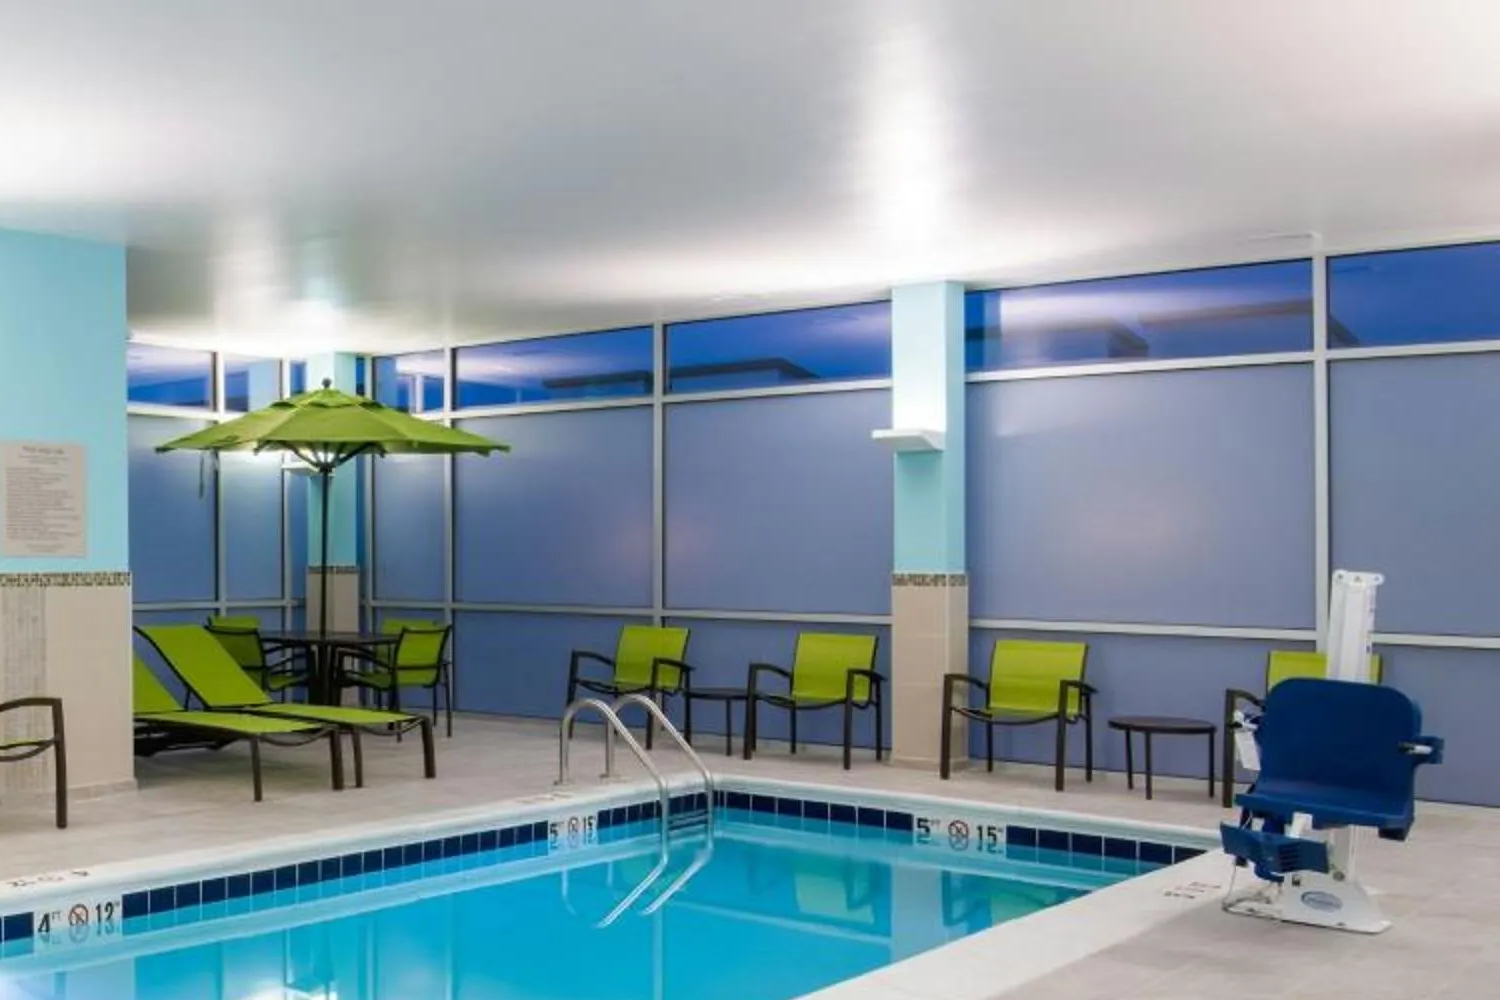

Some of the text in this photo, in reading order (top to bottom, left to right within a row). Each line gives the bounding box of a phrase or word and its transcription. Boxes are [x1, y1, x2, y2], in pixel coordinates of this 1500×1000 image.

[916, 817, 930, 836] 5
[976, 824, 997, 843] 15
[38, 912, 50, 933] 4
